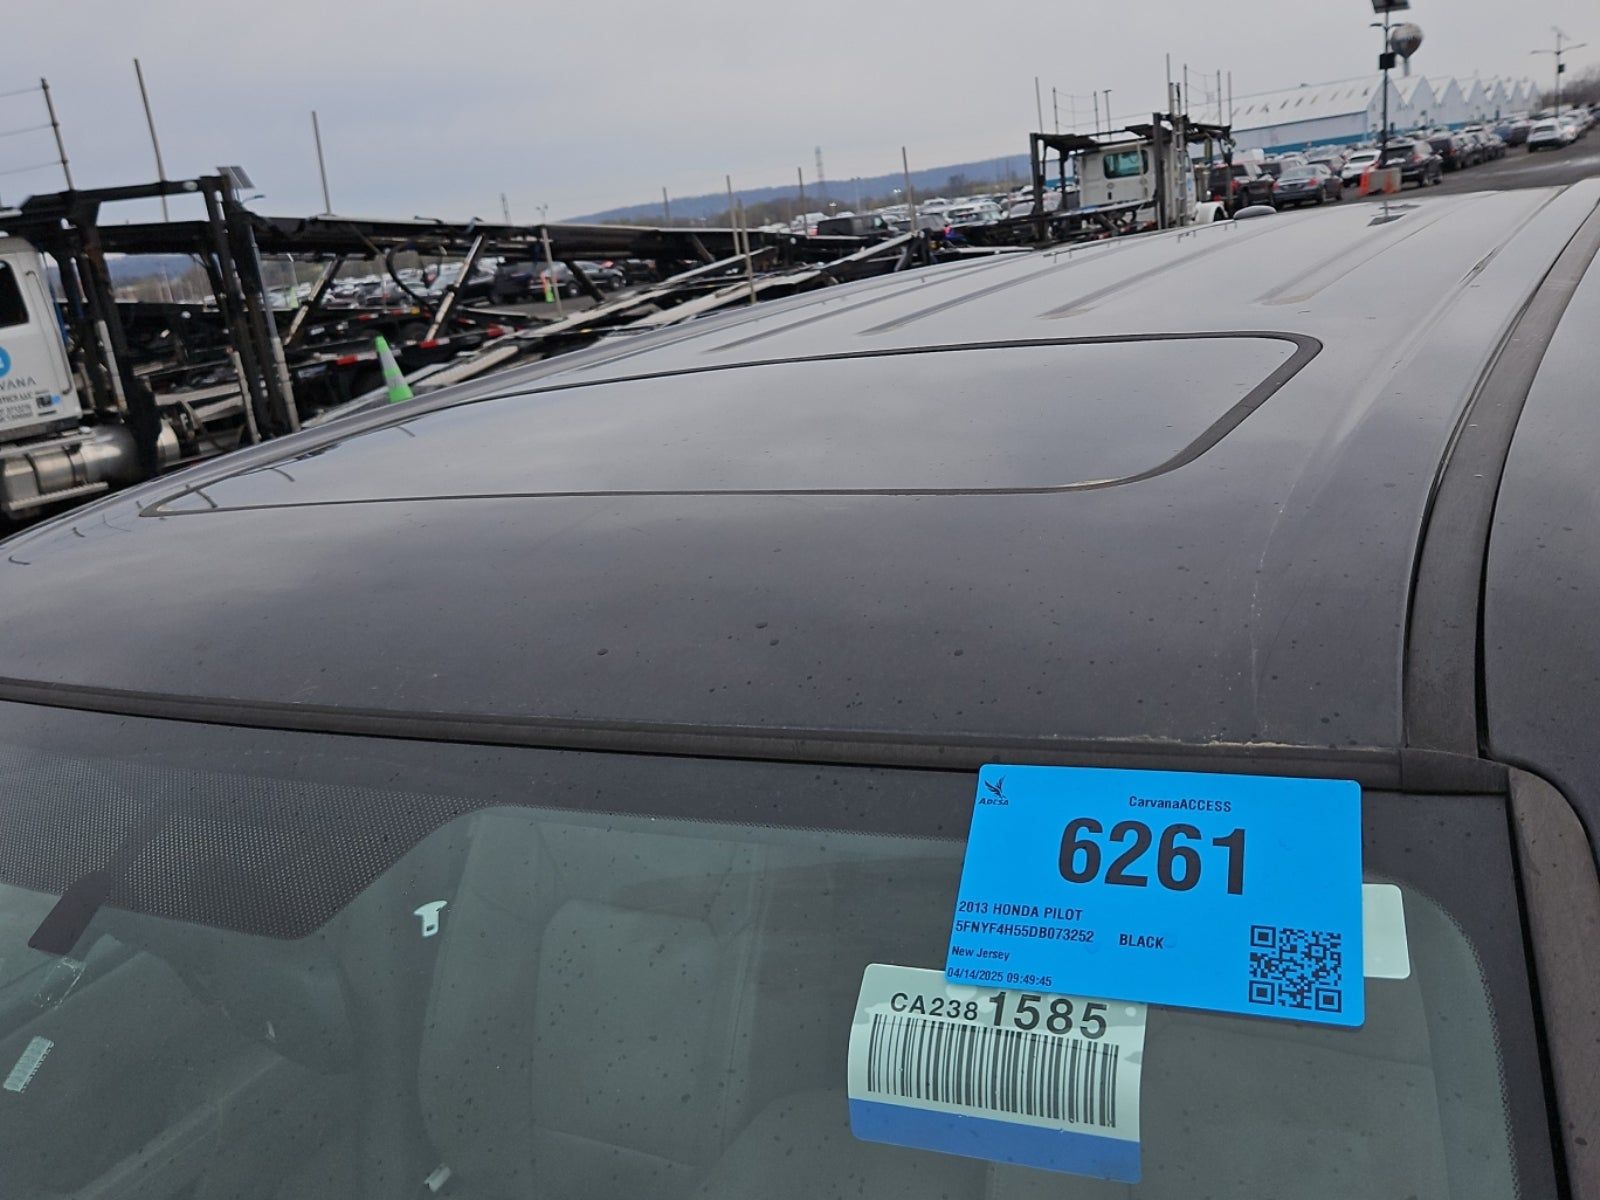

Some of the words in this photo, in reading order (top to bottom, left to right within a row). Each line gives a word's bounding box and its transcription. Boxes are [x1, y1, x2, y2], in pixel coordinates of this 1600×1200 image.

[979, 797, 1009, 806] ADESA
[1129, 795, 1232, 813] CarvanaACCESS
[1058, 817, 1246, 895] 6261
[958, 901, 988, 914] 2013
[993, 904, 1039, 918] HONDA
[1044, 907, 1083, 921] PILOT
[955, 920, 1095, 943] 5FNYF4H55DB073252
[1119, 933, 1164, 949] BLACK
[951, 945, 973, 957] New
[976, 949, 1010, 962] Jersey
[947, 967, 1003, 982] 04/14/2025
[1006, 973, 1053, 987] 09:49:45
